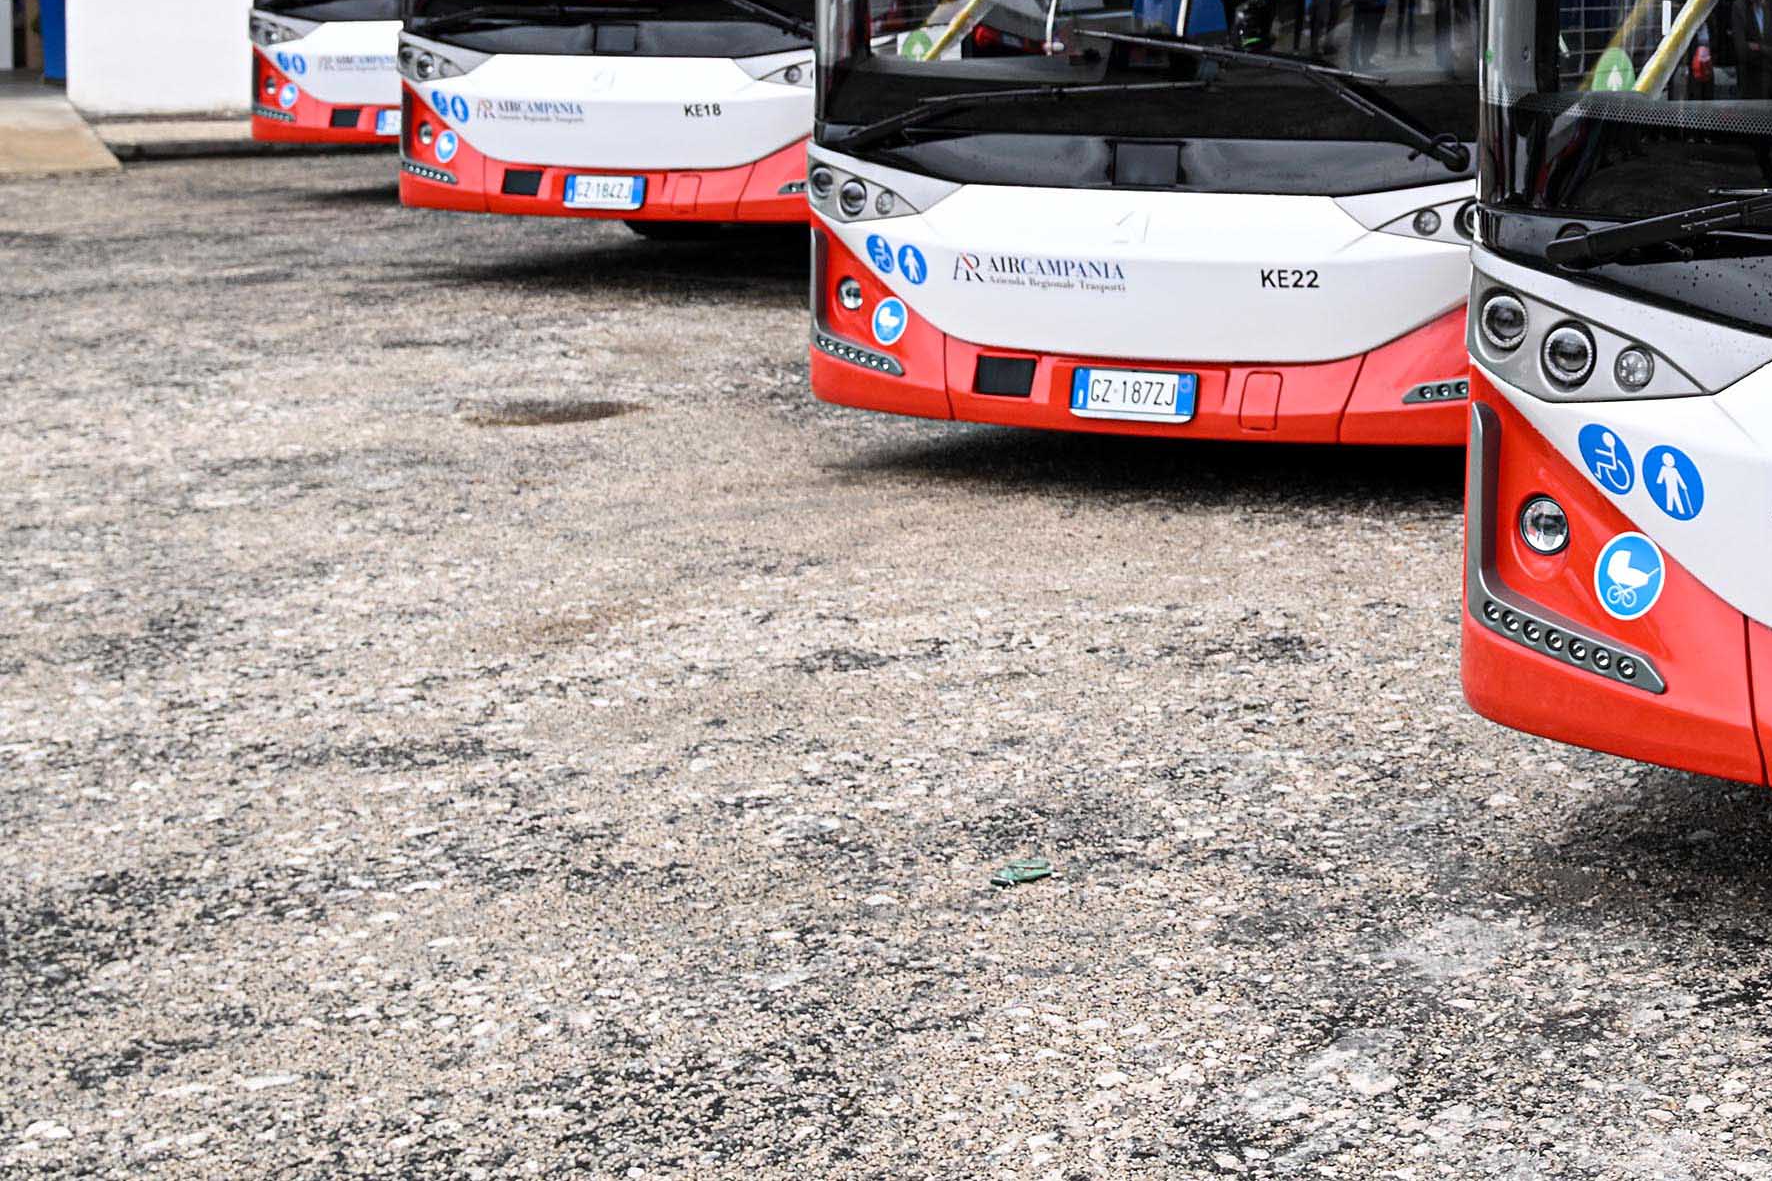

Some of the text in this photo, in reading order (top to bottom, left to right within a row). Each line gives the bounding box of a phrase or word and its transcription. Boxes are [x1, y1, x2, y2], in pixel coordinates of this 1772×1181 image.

[684, 103, 722, 118] KE18
[988, 256, 1125, 280] AIRCAMPANIA
[1260, 269, 1320, 289] KE22
